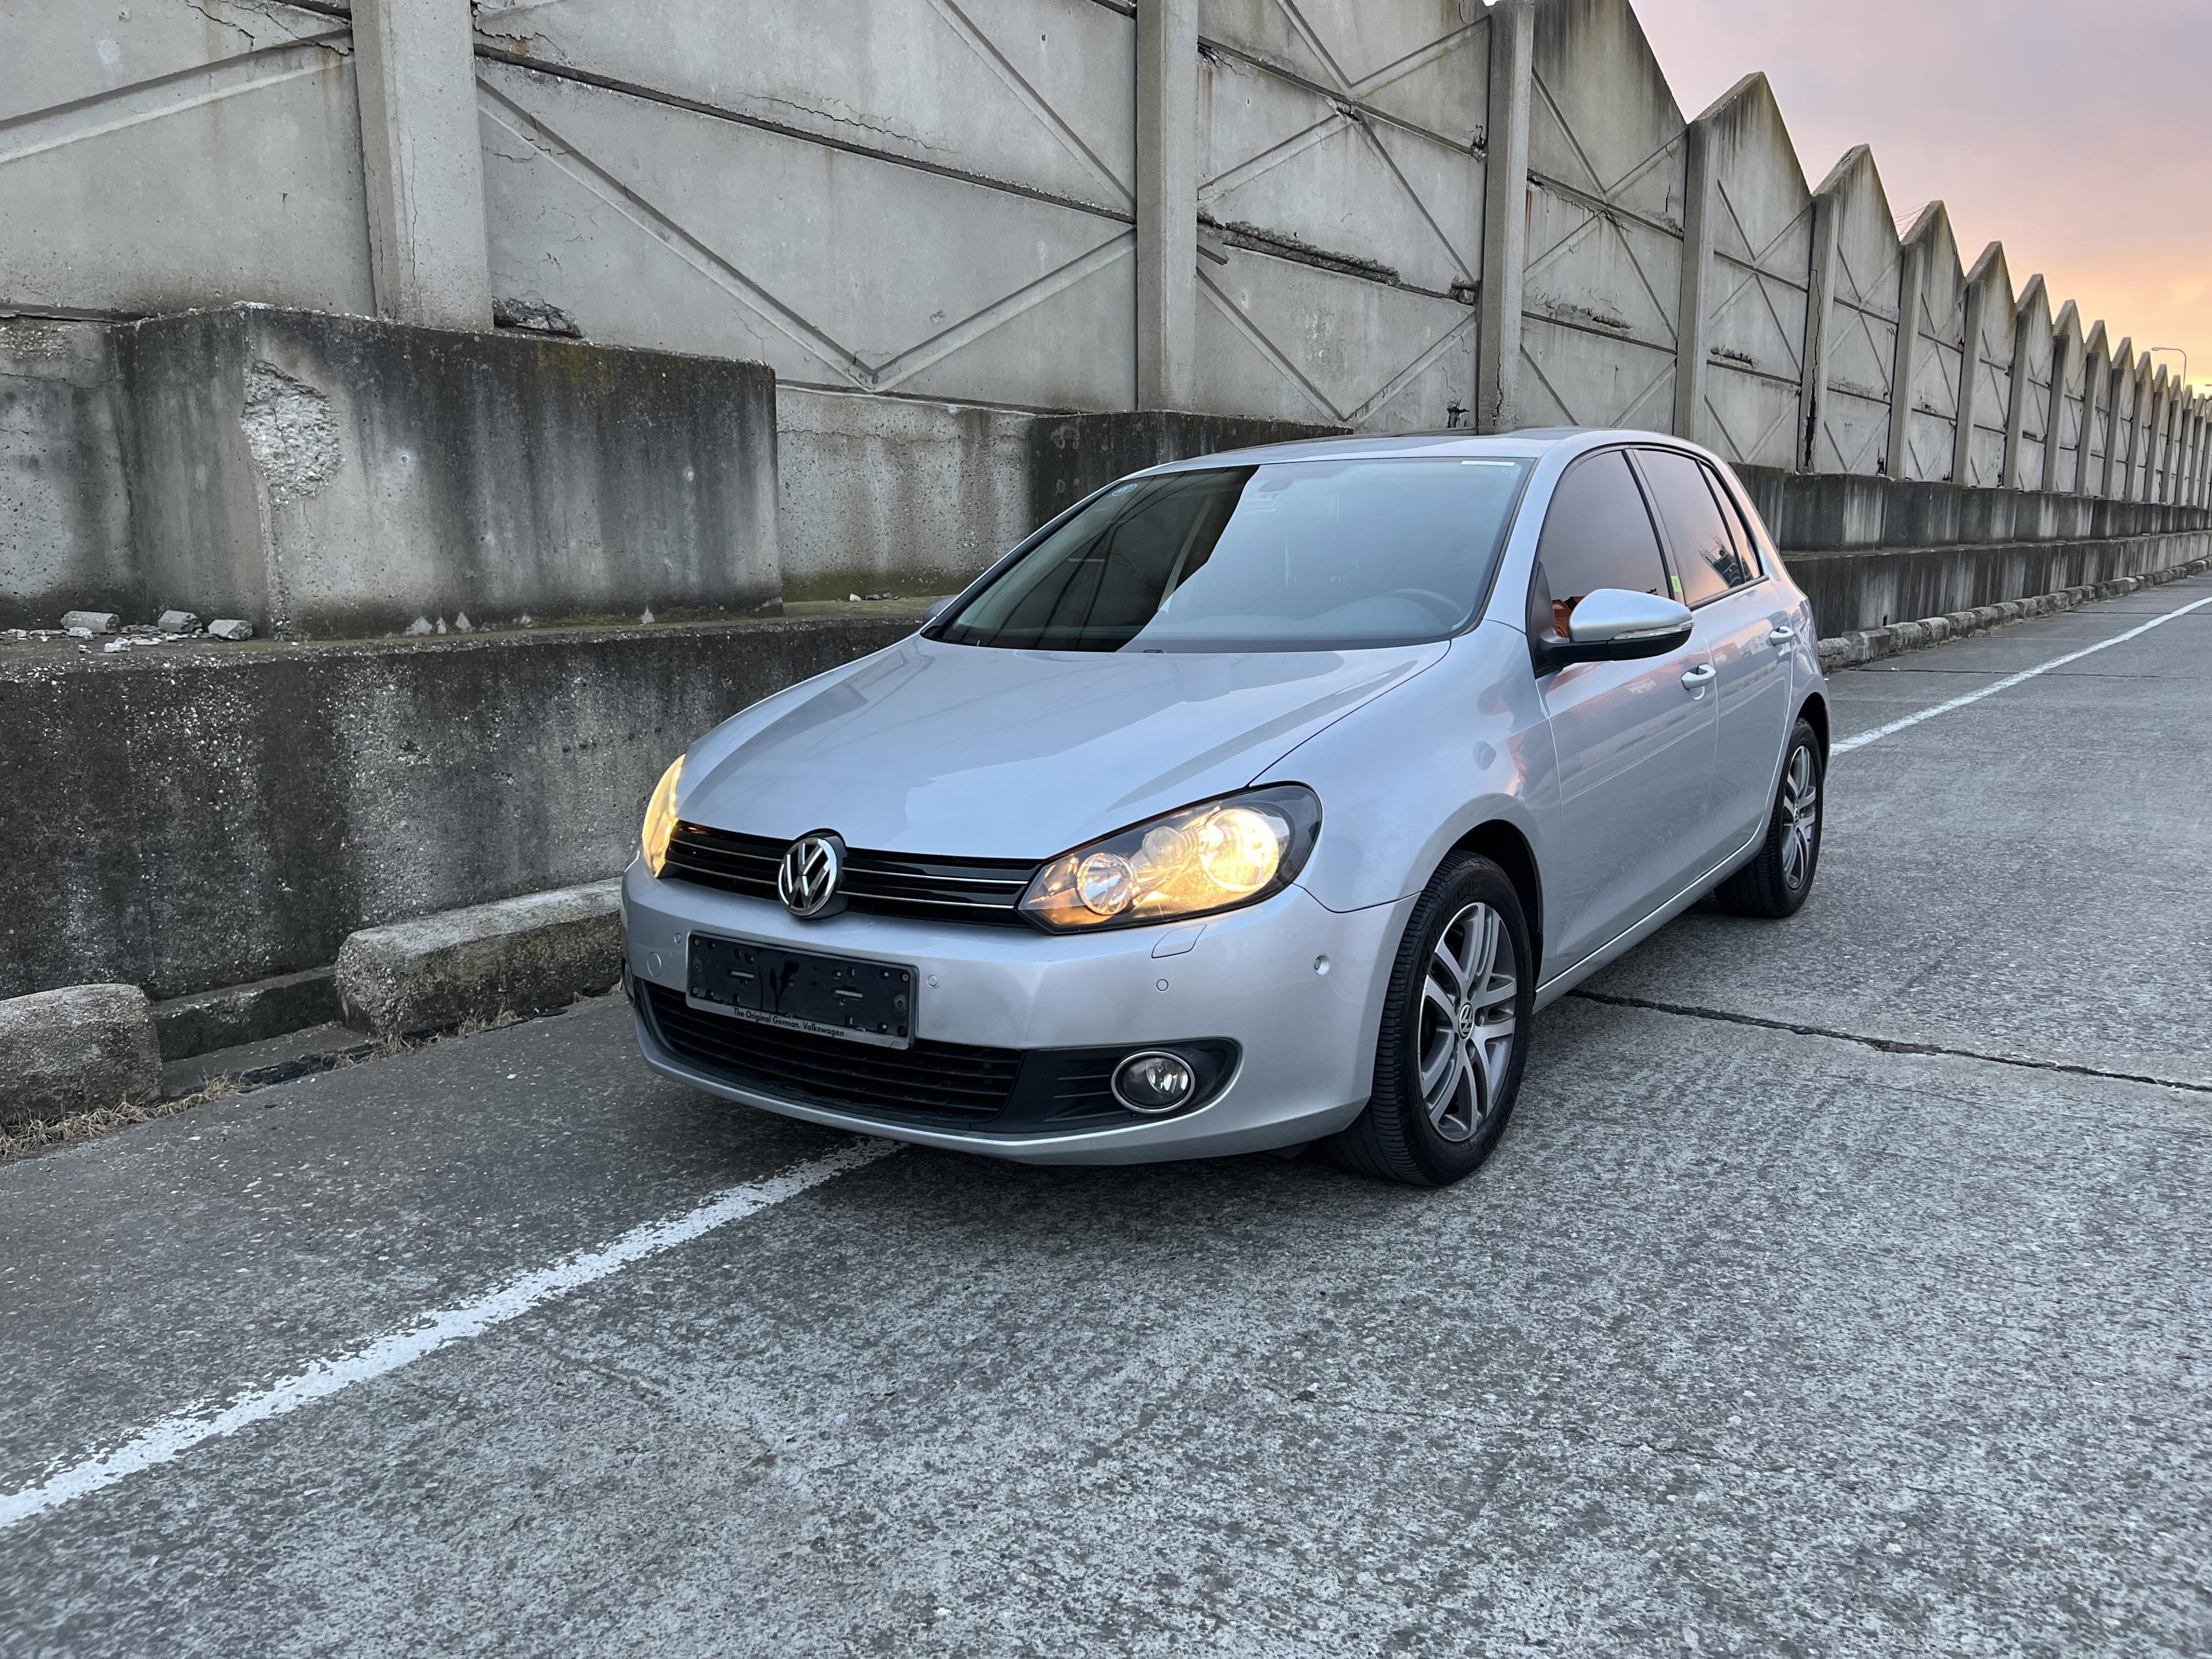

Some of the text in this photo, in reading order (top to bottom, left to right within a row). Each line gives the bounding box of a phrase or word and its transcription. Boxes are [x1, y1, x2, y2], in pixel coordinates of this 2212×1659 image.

[778, 837, 836, 916] VW
[734, 1007, 844, 1037] The Original German. Volkswagen
